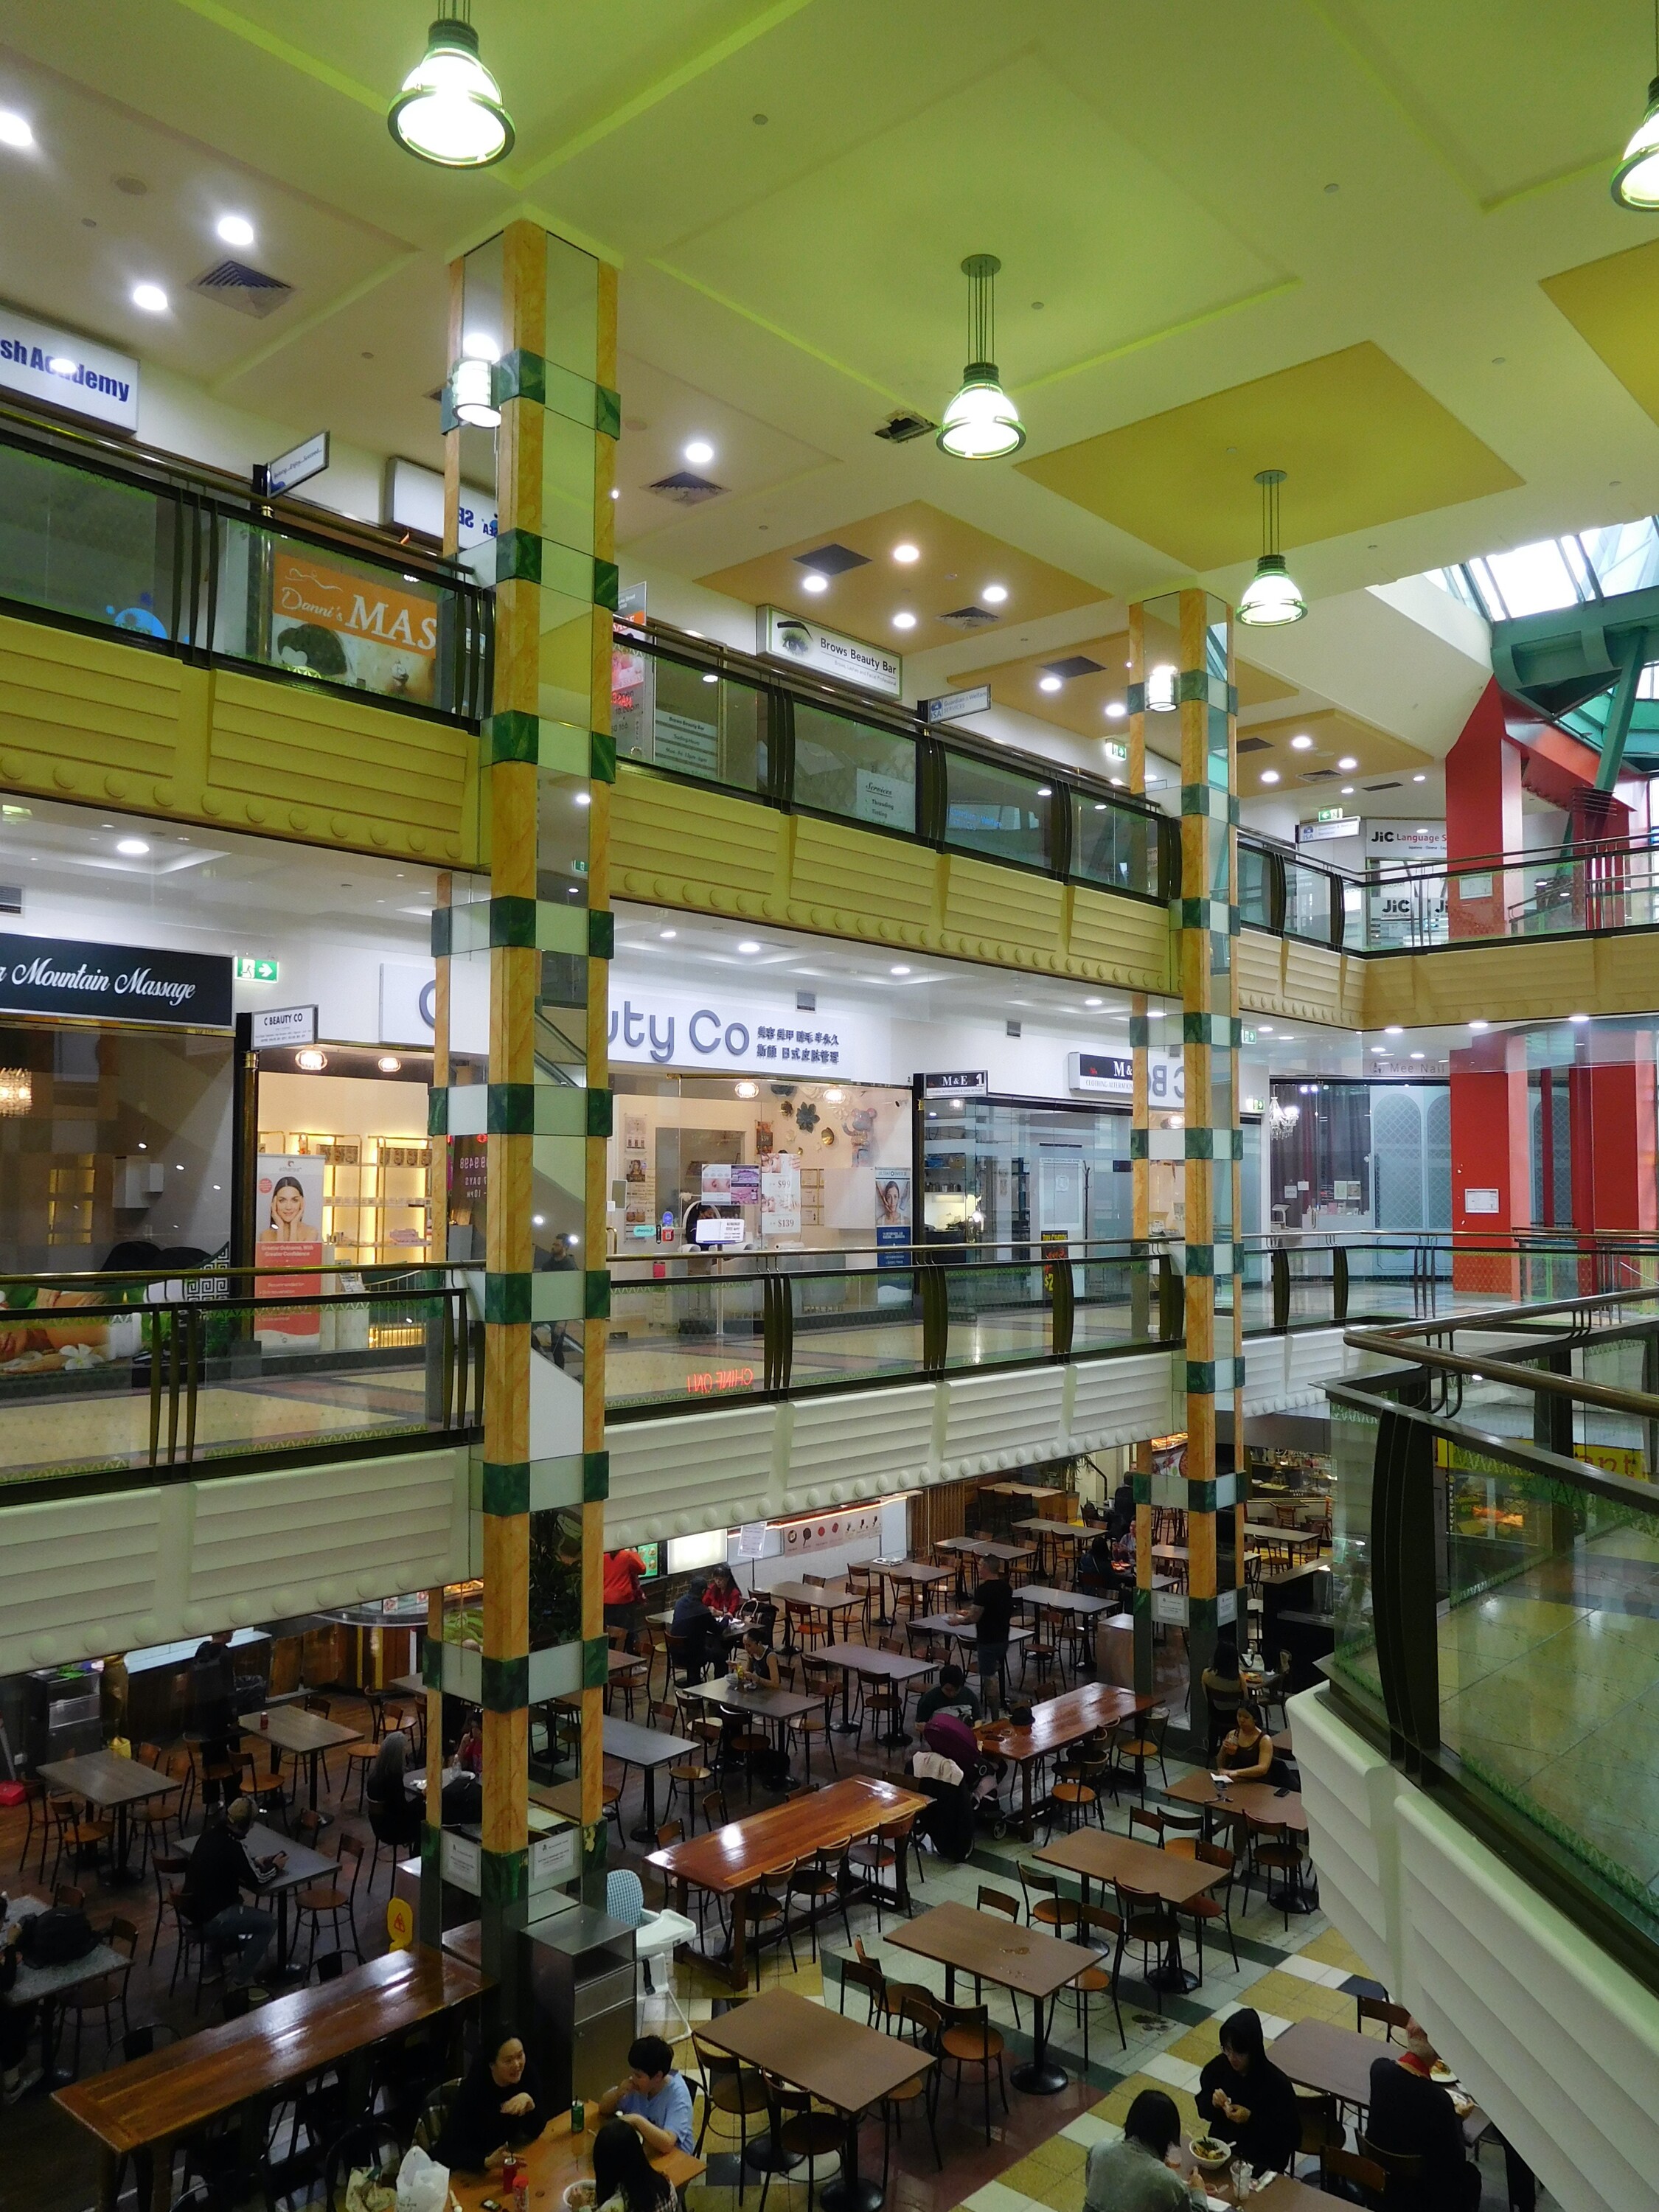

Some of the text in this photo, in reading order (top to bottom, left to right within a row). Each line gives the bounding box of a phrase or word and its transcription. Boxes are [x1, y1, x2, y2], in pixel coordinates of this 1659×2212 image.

[0, 339, 27, 366] sh
[821, 638, 897, 674] Brows Beauty Bar
[866, 782, 892, 795] Services
[1371, 831, 1394, 843] JiC
[1397, 833, 1439, 843] Language
[1382, 900, 1410, 913] JiC
[12, 957, 111, 992] Mountain
[114, 967, 196, 1006] Massage
[269, 1015, 292, 1025] BEAUTY
[293, 1013, 303, 1023] CO
[689, 1009, 751, 1056] Co
[1390, 1063, 1444, 1074] Mee Nail
[778, 1180, 791, 1189] $99
[778, 1219, 794, 1228] $139
